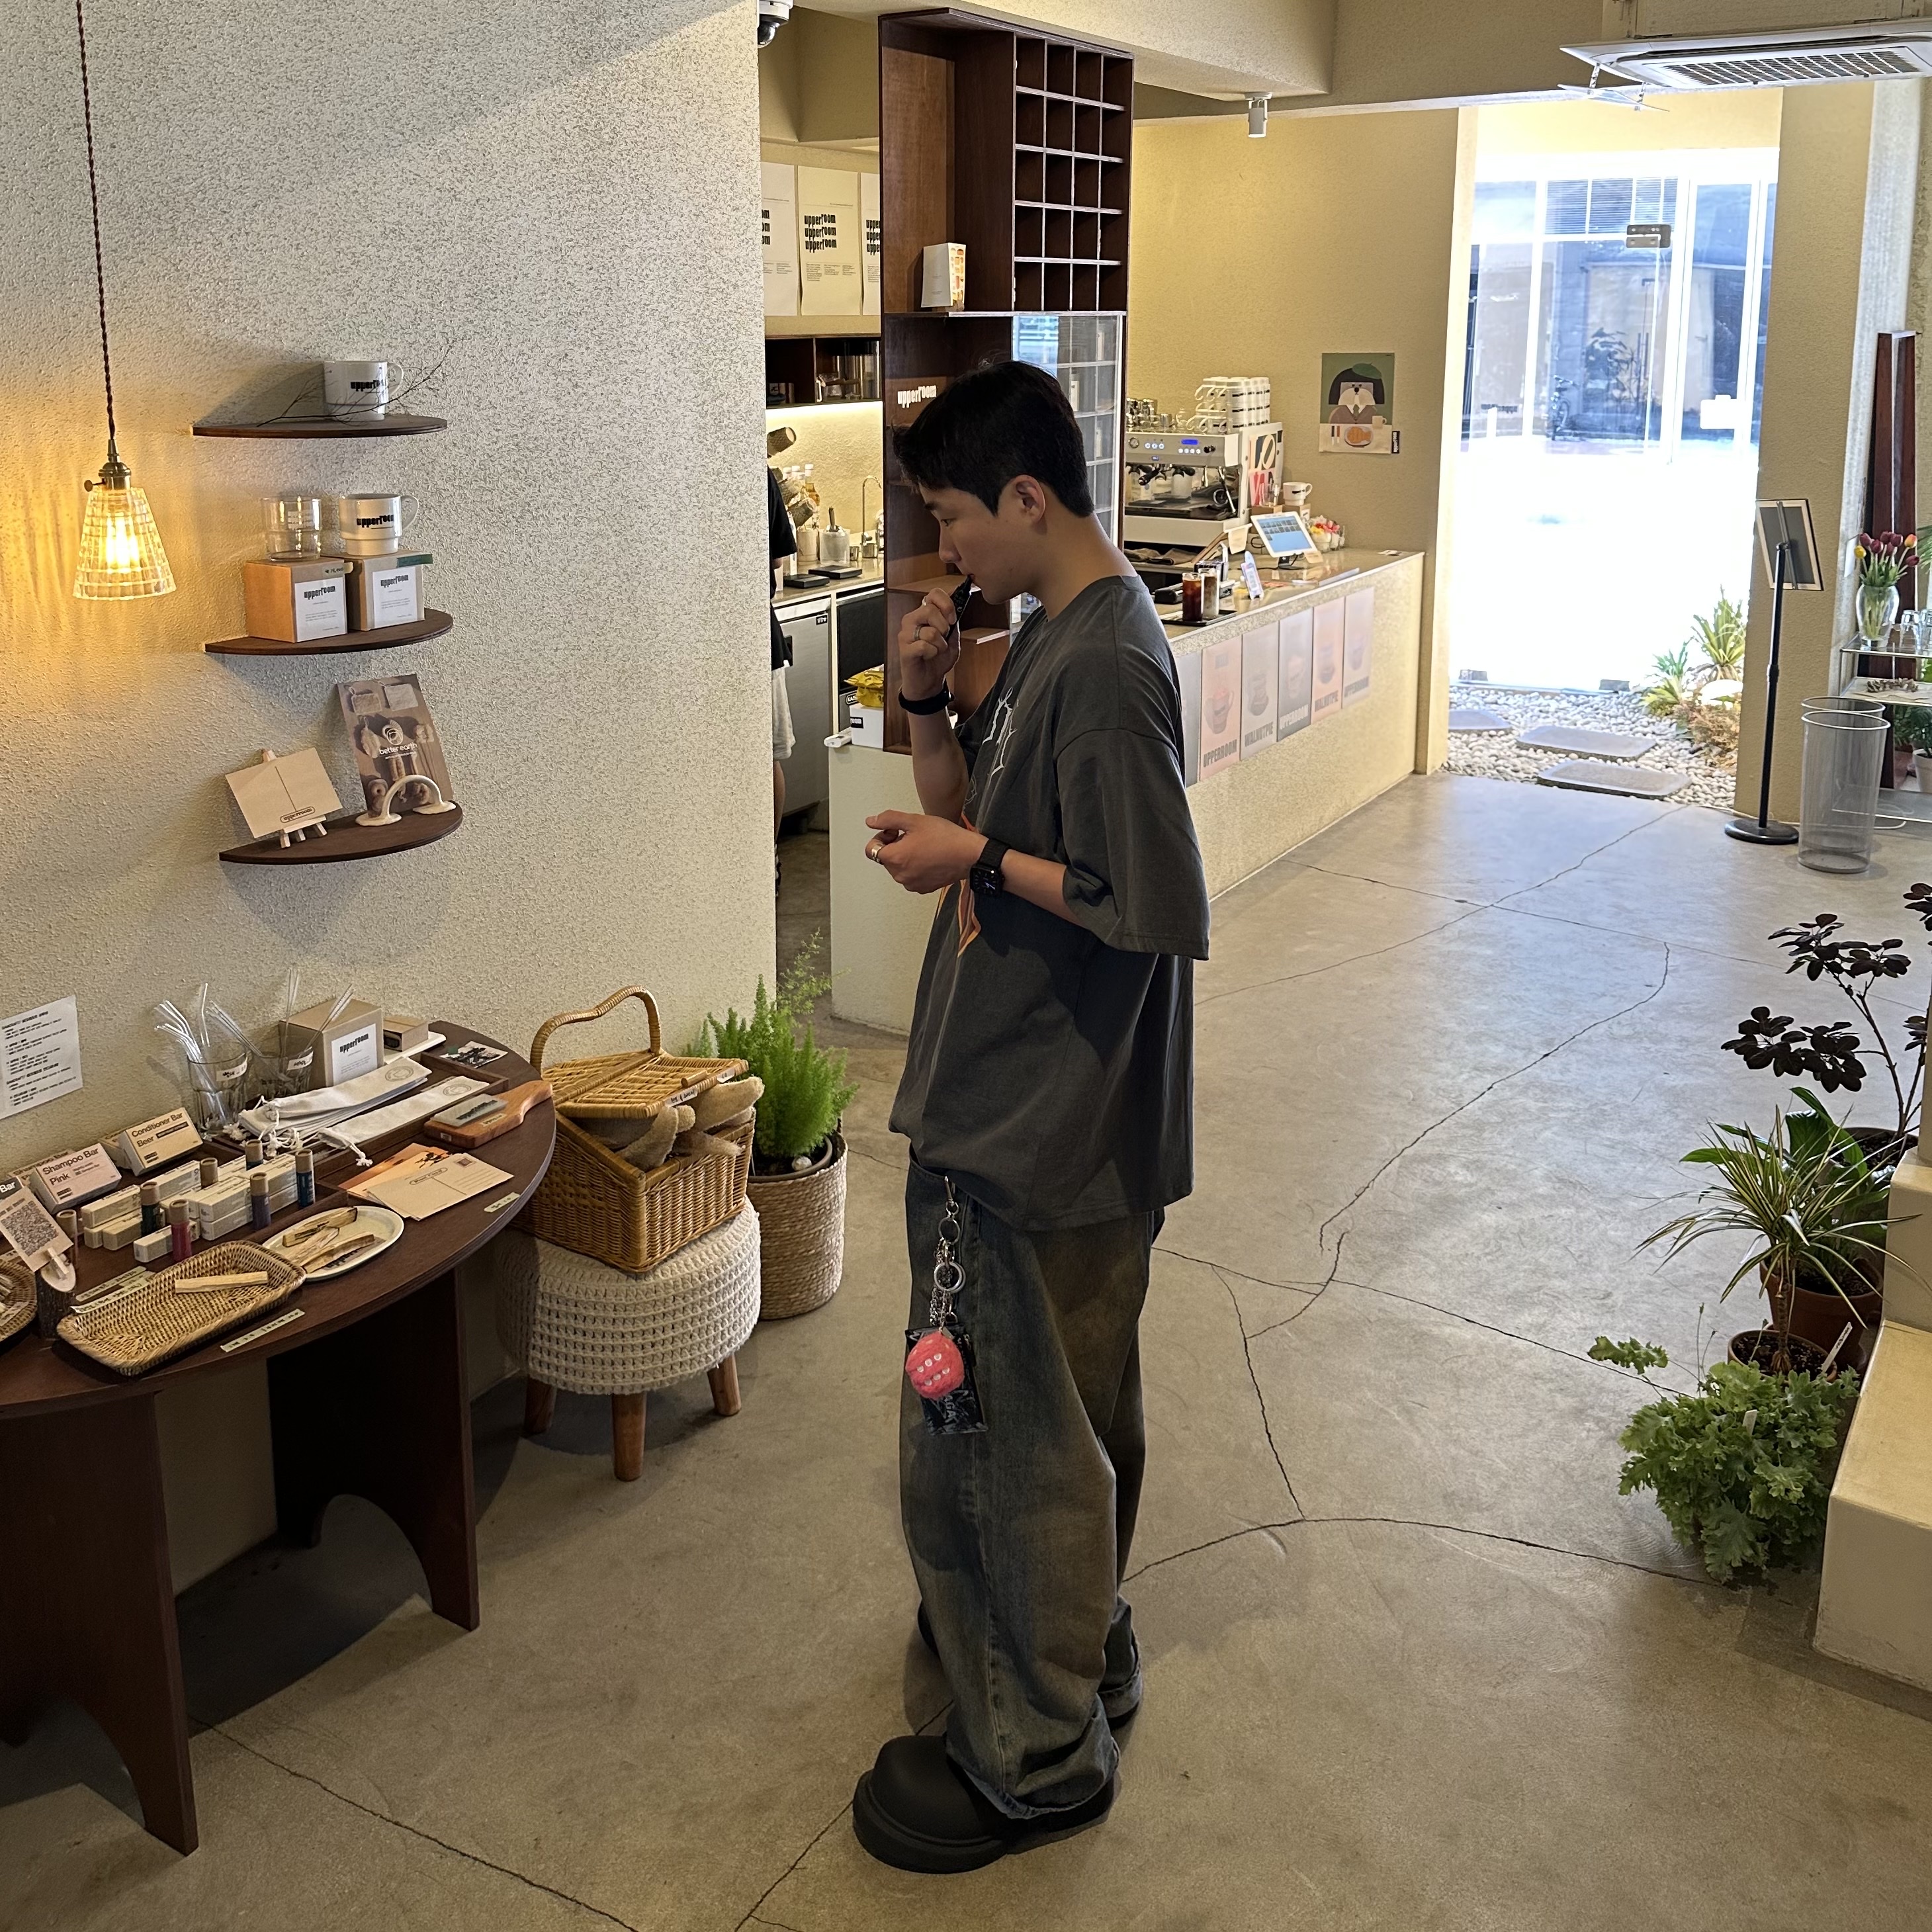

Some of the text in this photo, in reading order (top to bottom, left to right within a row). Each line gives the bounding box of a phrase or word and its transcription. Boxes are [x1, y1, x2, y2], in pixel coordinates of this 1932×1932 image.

[804, 214, 836, 228] upperroom
[805, 226, 837, 240] upperroom
[805, 239, 837, 253] upperroom
[897, 385, 937, 408] upperroom
[380, 574, 409, 588] upperroom
[304, 586, 336, 600] upperroom
[1245, 721, 1274, 747] WALNUTPIE
[379, 742, 417, 755] better earth
[1203, 739, 1237, 768] UPPERROOM
[339, 1033, 369, 1053] upperroom
[132, 1118, 170, 1137] Conditioner
[170, 1113, 183, 1121] Bar
[136, 1136, 154, 1147] Beer
[42, 1155, 83, 1175] Shampoo
[83, 1148, 99, 1158] Bar
[50, 1172, 70, 1186] Pink
[0, 1181, 16, 1192] Bar
